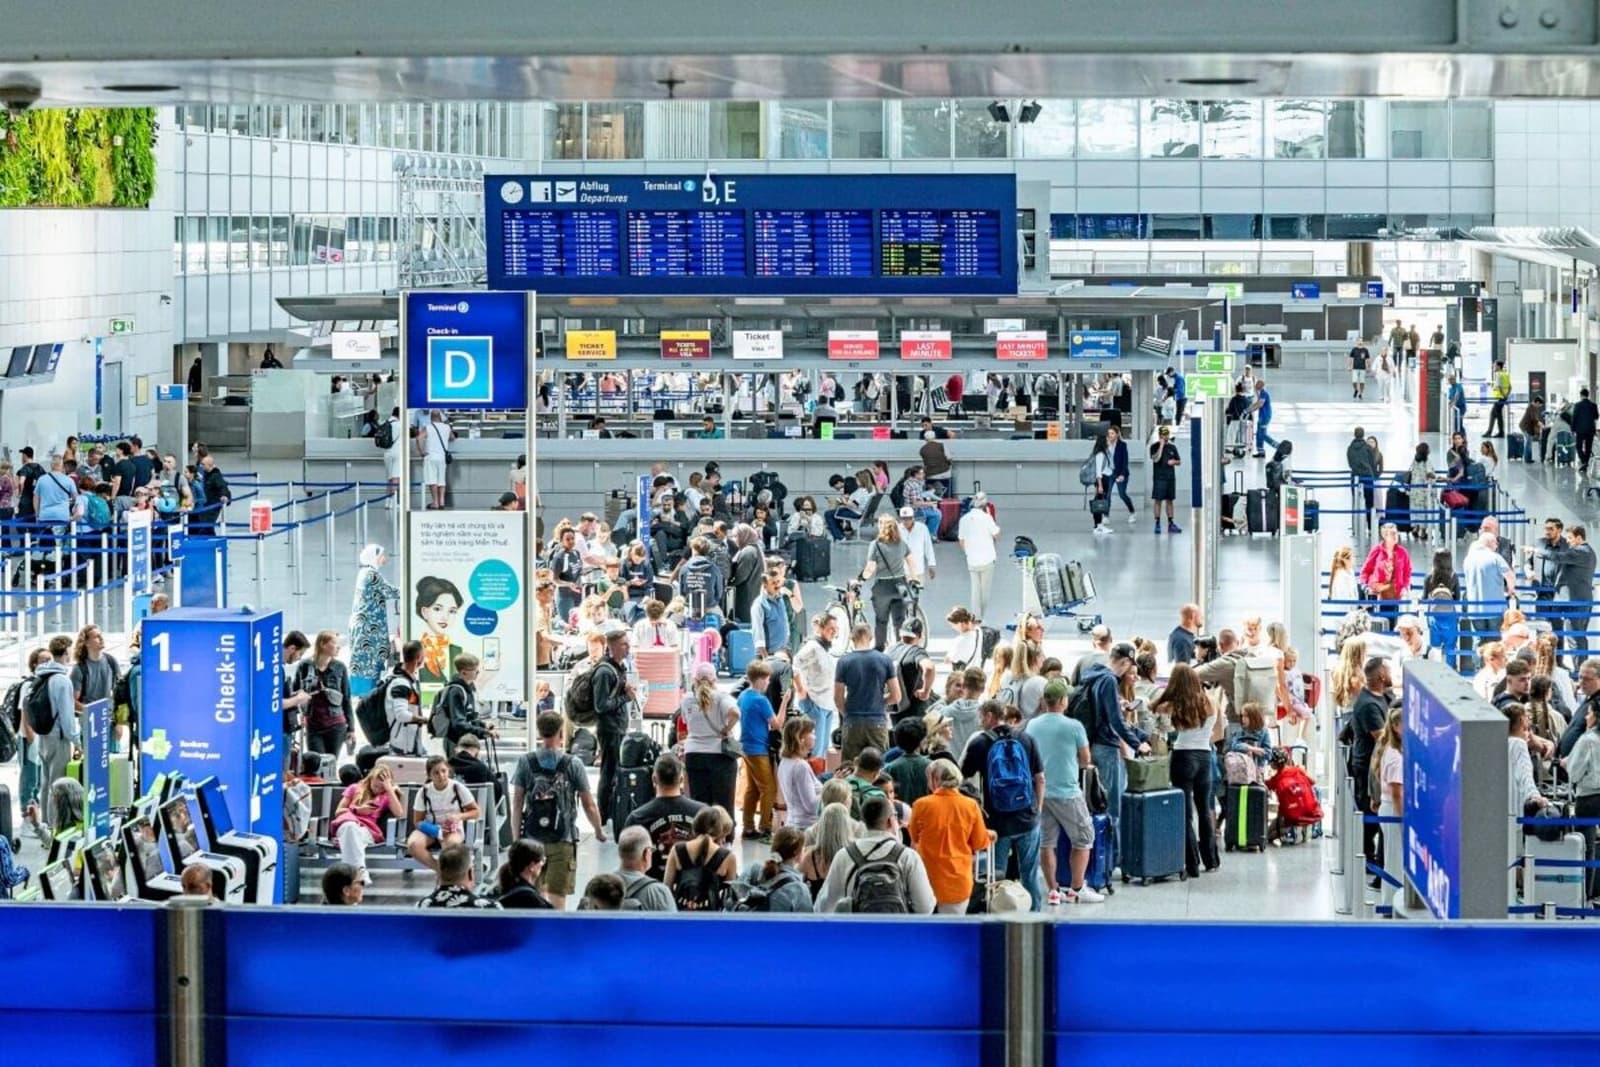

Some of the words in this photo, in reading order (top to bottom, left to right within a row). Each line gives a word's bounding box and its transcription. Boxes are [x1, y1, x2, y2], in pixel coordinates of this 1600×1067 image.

[580, 181, 609, 192] Abflug
[644, 181, 682, 191] Terminal
[580, 193, 629, 204] Departures
[427, 303, 456, 311] Terminal
[427, 327, 459, 335] Check-in
[743, 332, 770, 341] Ticket
[445, 350, 476, 388] D
[151, 632, 182, 672] 1.
[271, 625, 279, 713] Check-in
[215, 634, 235, 723] Check-in
